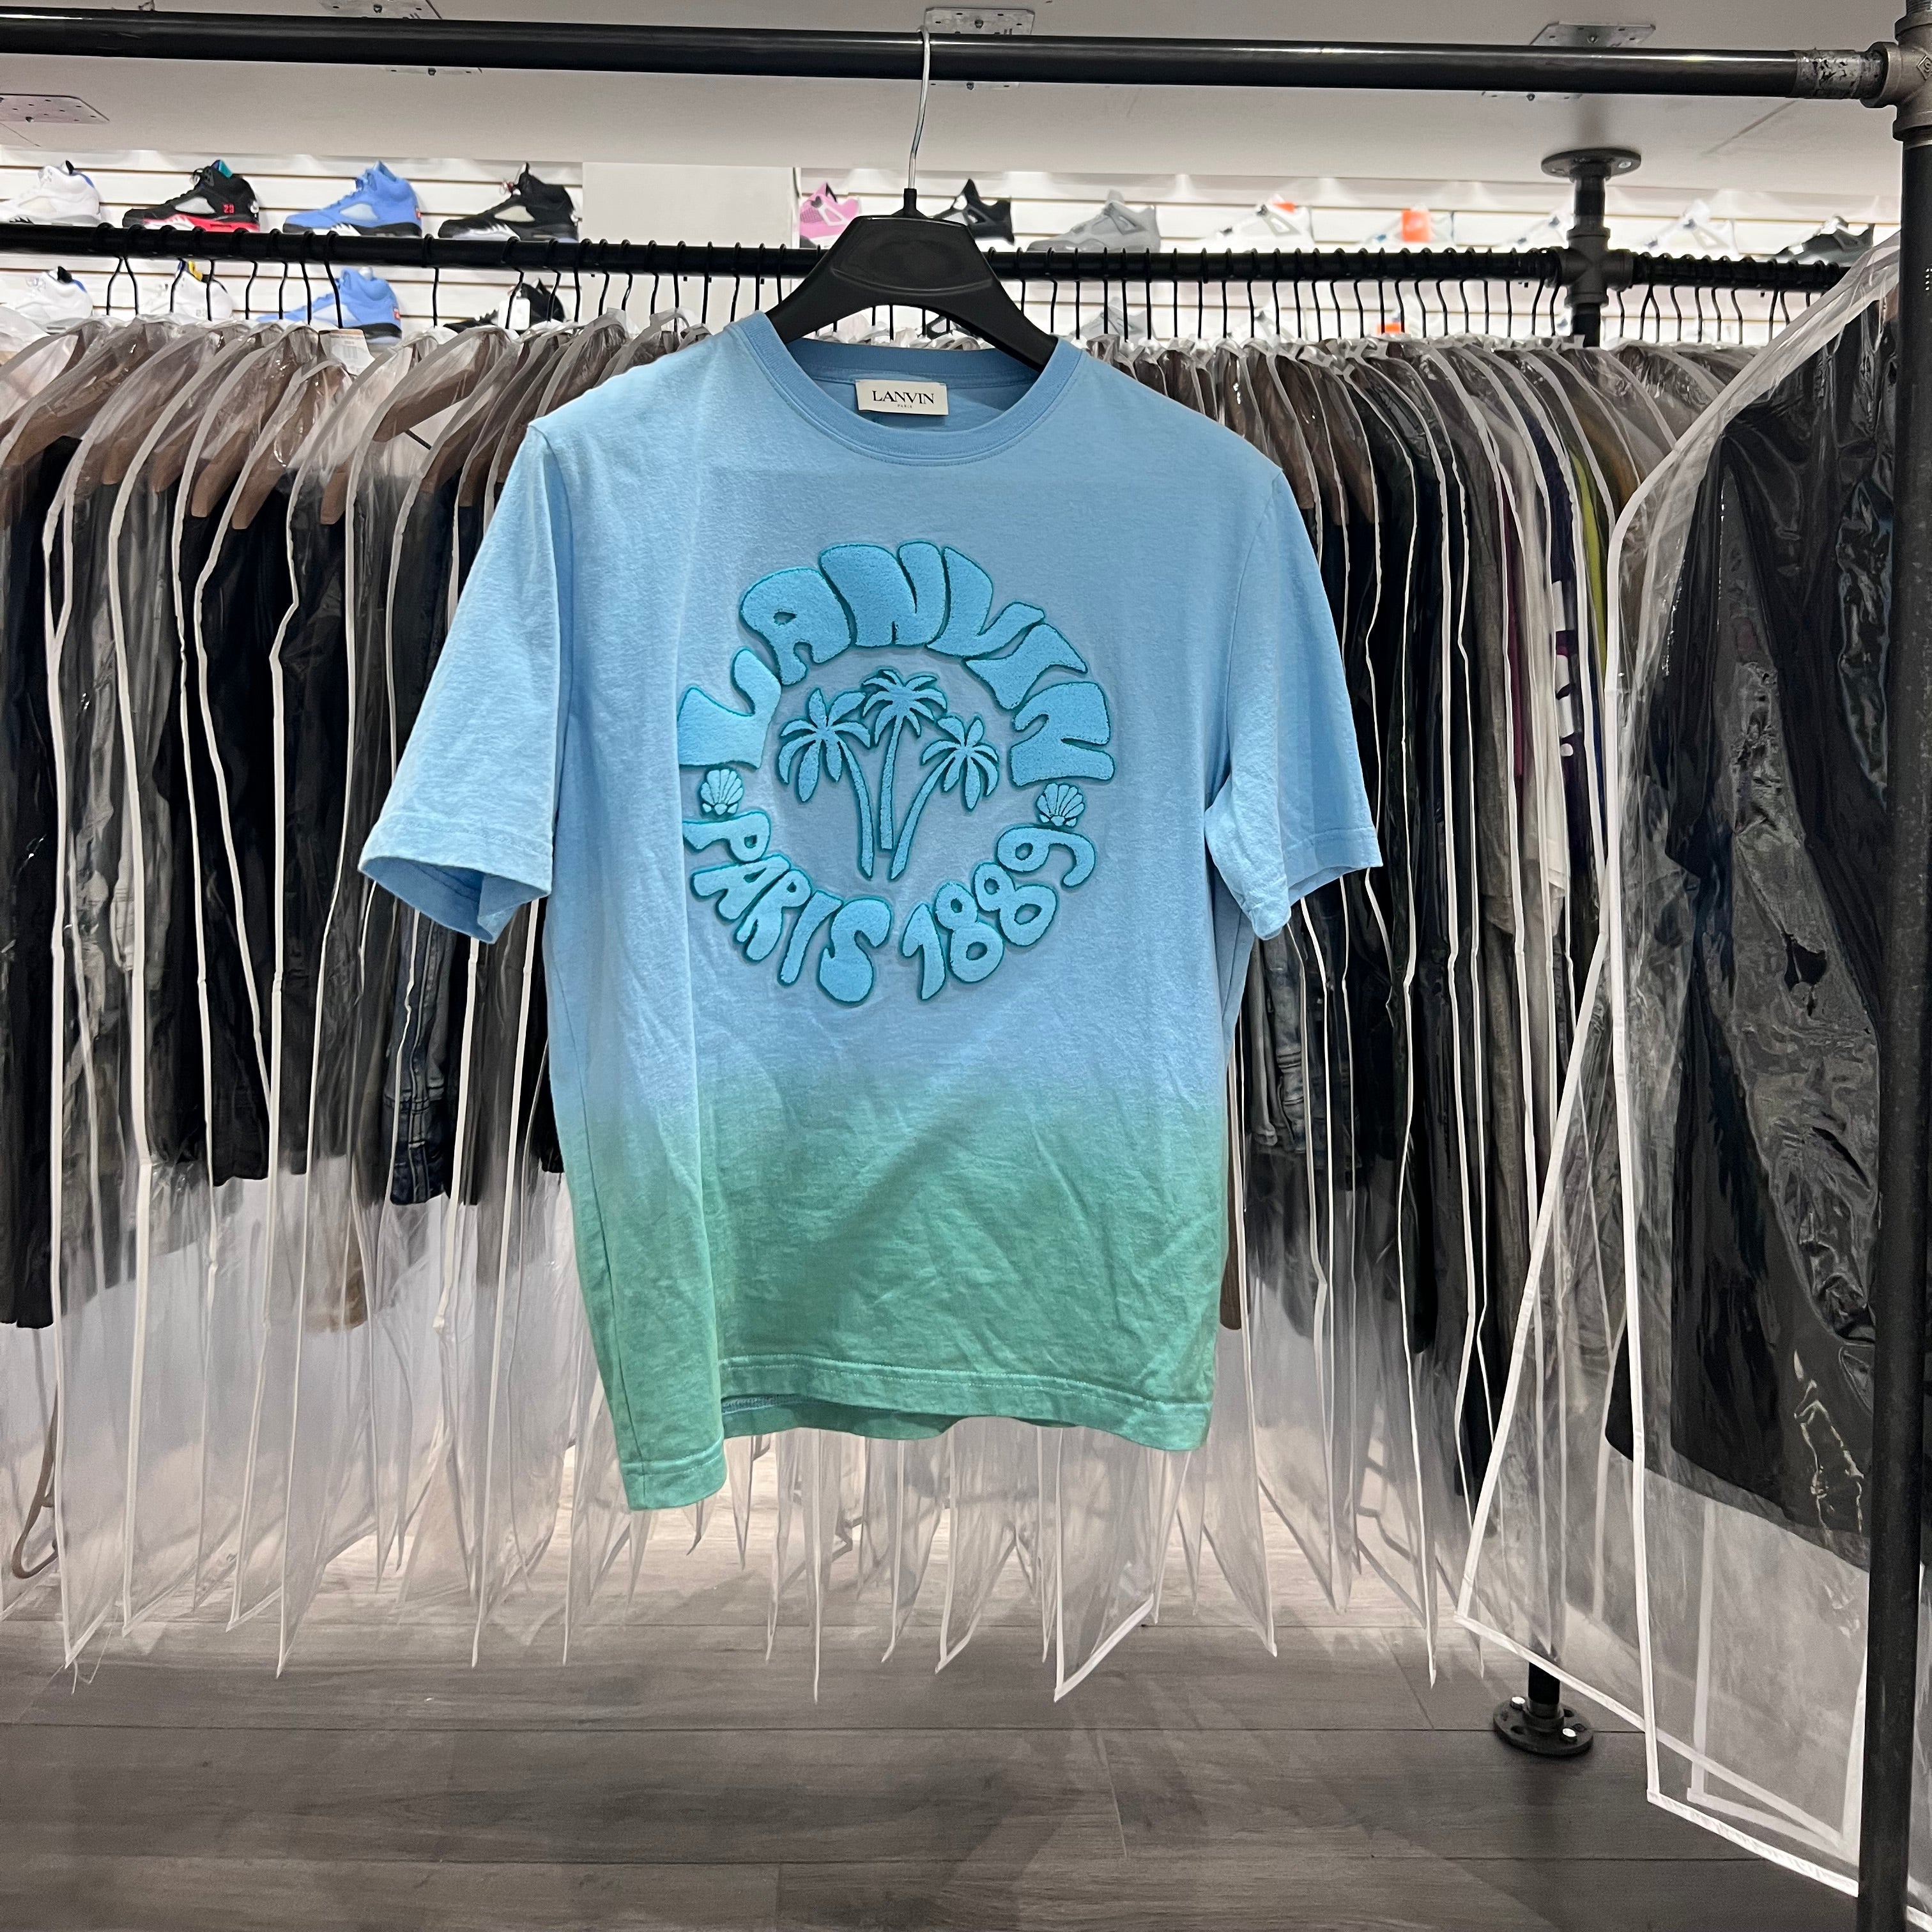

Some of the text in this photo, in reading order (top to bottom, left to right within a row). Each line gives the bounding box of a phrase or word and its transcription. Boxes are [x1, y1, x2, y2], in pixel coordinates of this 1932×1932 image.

[872, 390, 934, 404] LANVIN
[677, 540, 1116, 787] LANVIN
[681, 810, 1097, 1006] PARIS 1889
